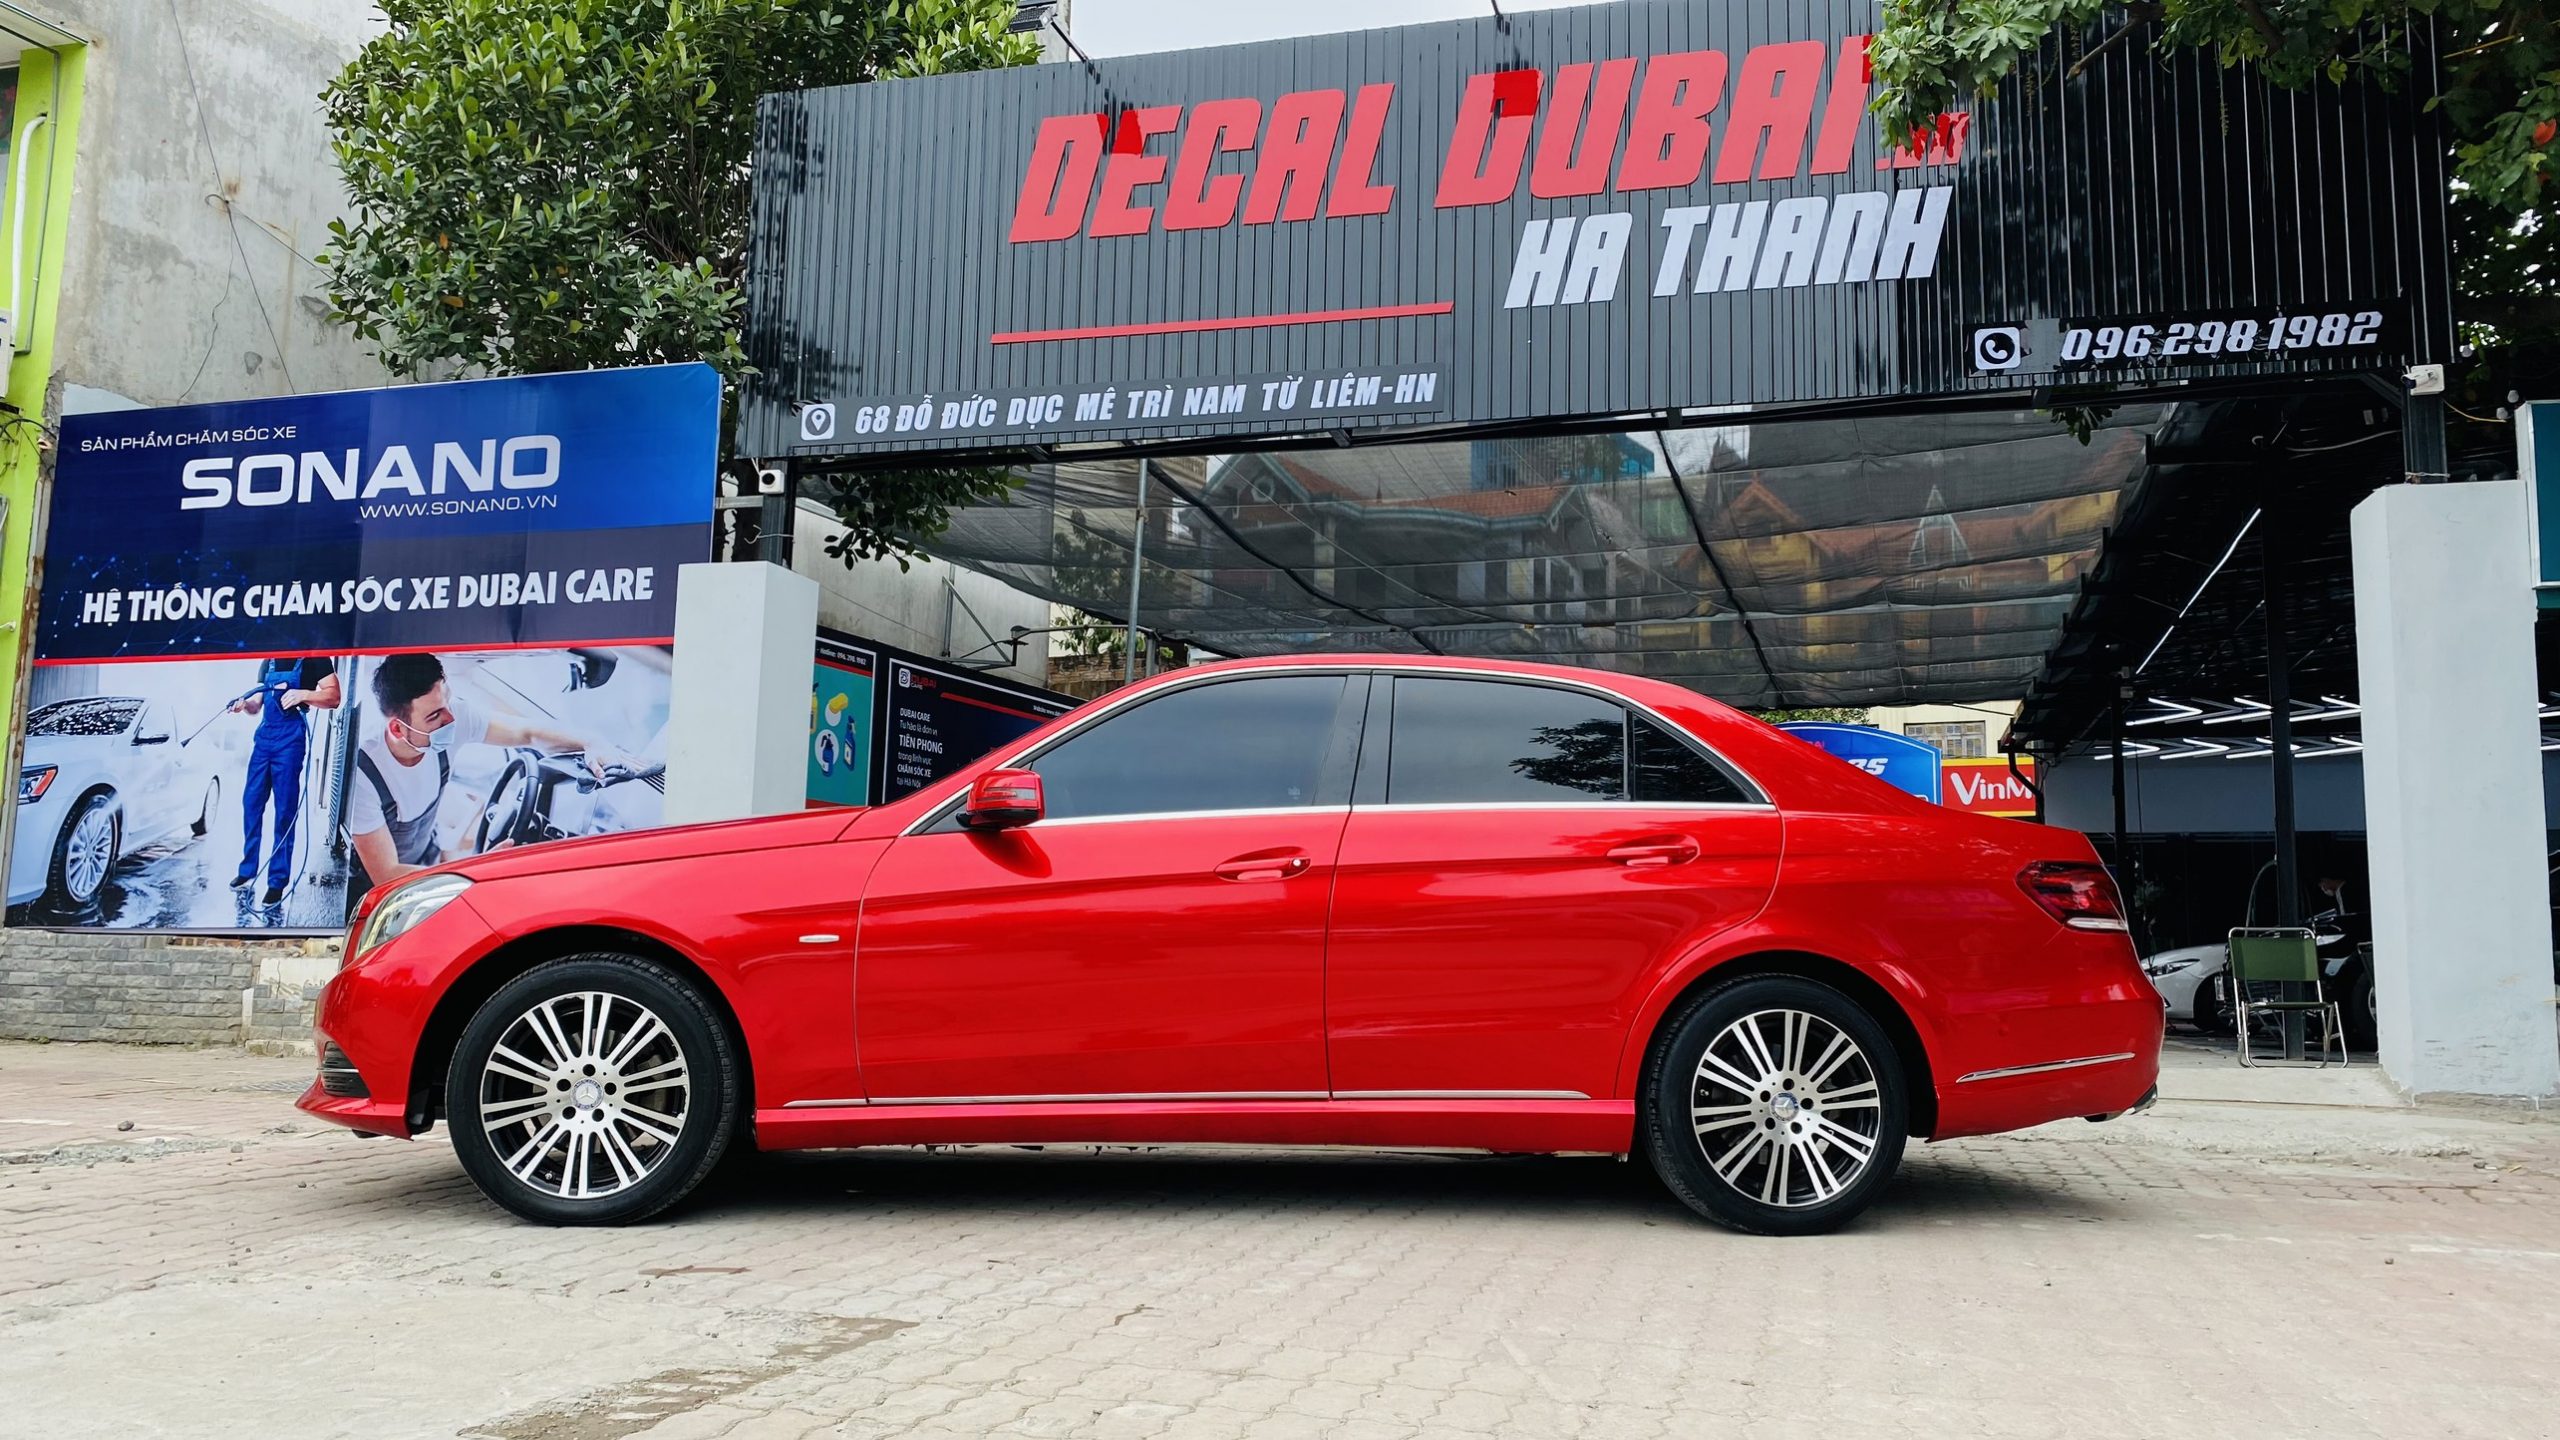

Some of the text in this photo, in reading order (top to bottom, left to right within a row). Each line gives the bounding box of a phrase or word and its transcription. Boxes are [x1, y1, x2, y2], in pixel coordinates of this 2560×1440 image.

[1009, 82, 1396, 243] DECAL
[1504, 186, 1953, 309] HA THANH
[854, 405, 891, 434] 68
[894, 394, 933, 432] ĐỖ
[940, 393, 998, 430] ĐỨC
[1006, 394, 1064, 430] DỤC
[1074, 386, 1117, 423] MÊ
[1127, 384, 1174, 419] TRÌ
[1182, 384, 1247, 417] NAM
[1261, 374, 1304, 412] TỪ
[81, 426, 297, 452] SẢN PHẨM CHĂM SÓC XE
[181, 435, 561, 511] SONANO
[360, 495, 557, 519] WWW.SONANO.VN
[82, 567, 654, 627] HỆ THỐNG CHĂM SÓC XE DUBAI CARE
[900, 707, 930, 722] DUBAI CARE
[916, 738, 943, 754] PHONG
